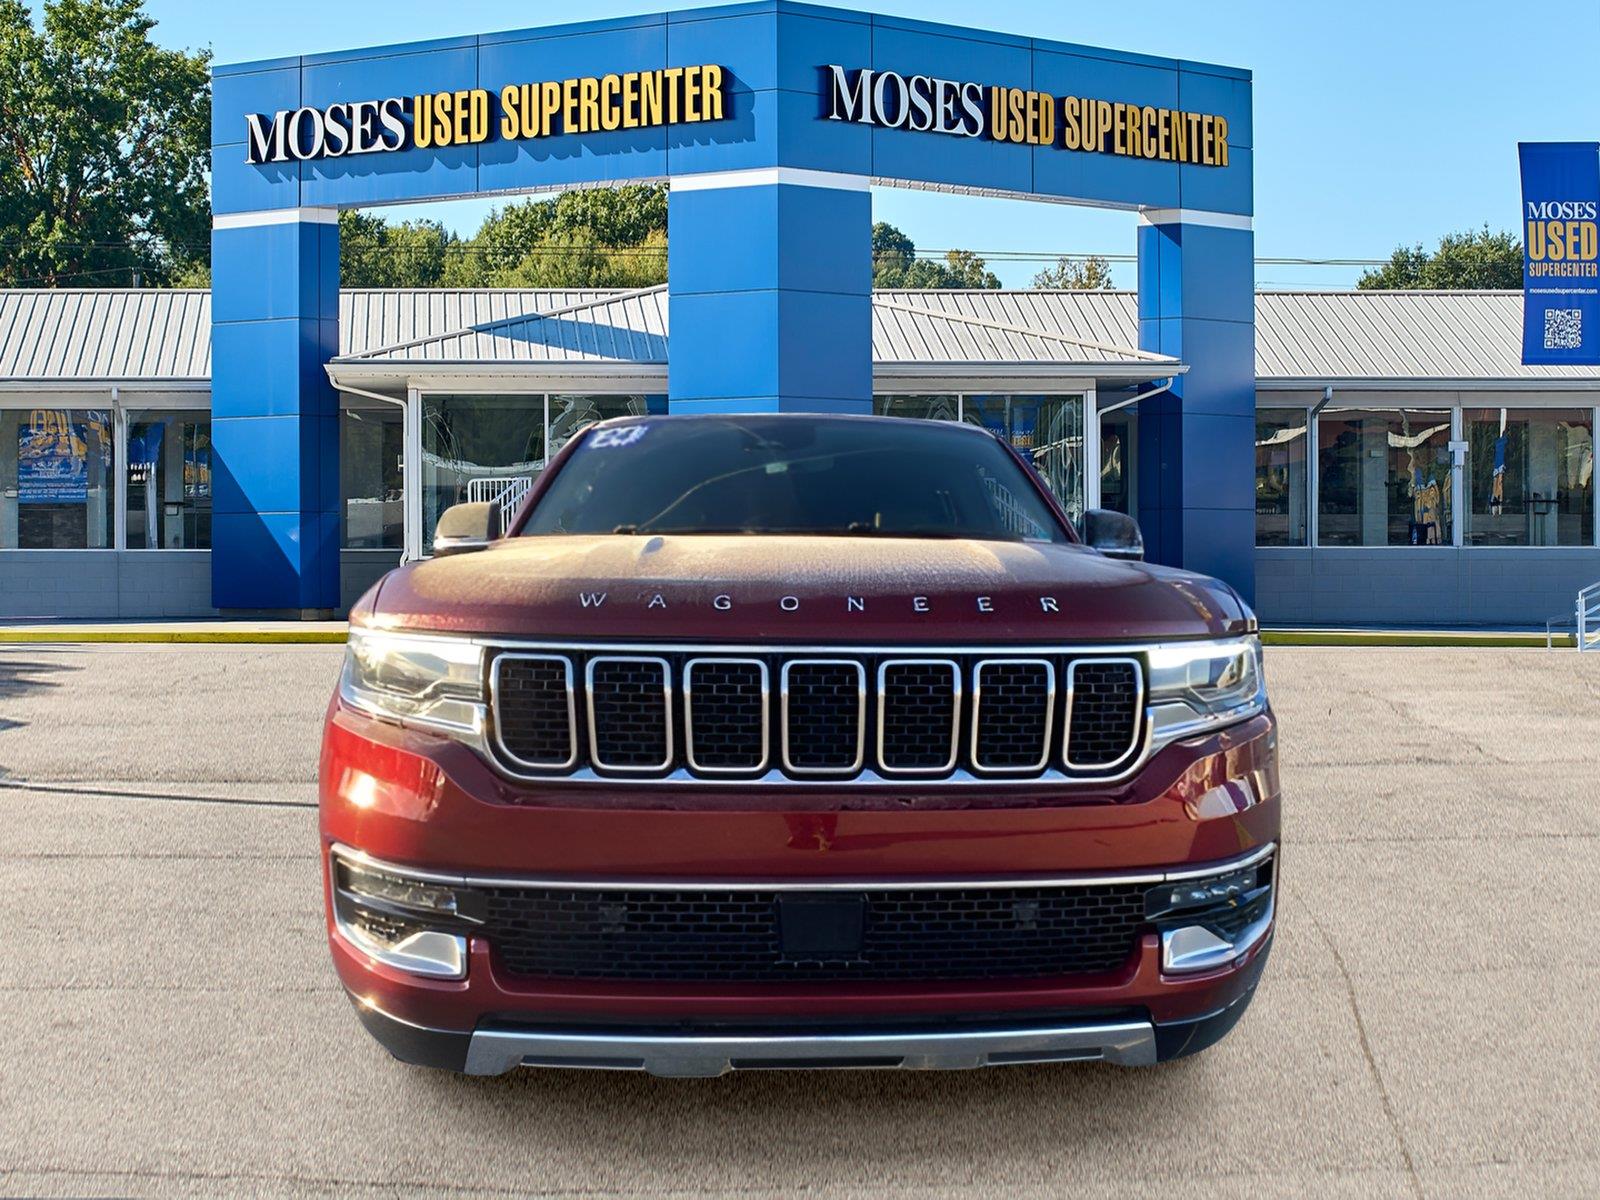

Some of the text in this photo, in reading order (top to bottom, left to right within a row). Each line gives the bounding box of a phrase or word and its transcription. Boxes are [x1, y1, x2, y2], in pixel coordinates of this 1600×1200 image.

[243, 64, 724, 165] MOSES USED SUPERCENTER
[828, 64, 1230, 167] MOSES USED SUPERCENTER
[1527, 201, 1597, 220] MOSES
[1528, 221, 1598, 261] USED
[1529, 262, 1598, 277] SUPERCENTER
[579, 591, 1060, 613] WAGONEER
